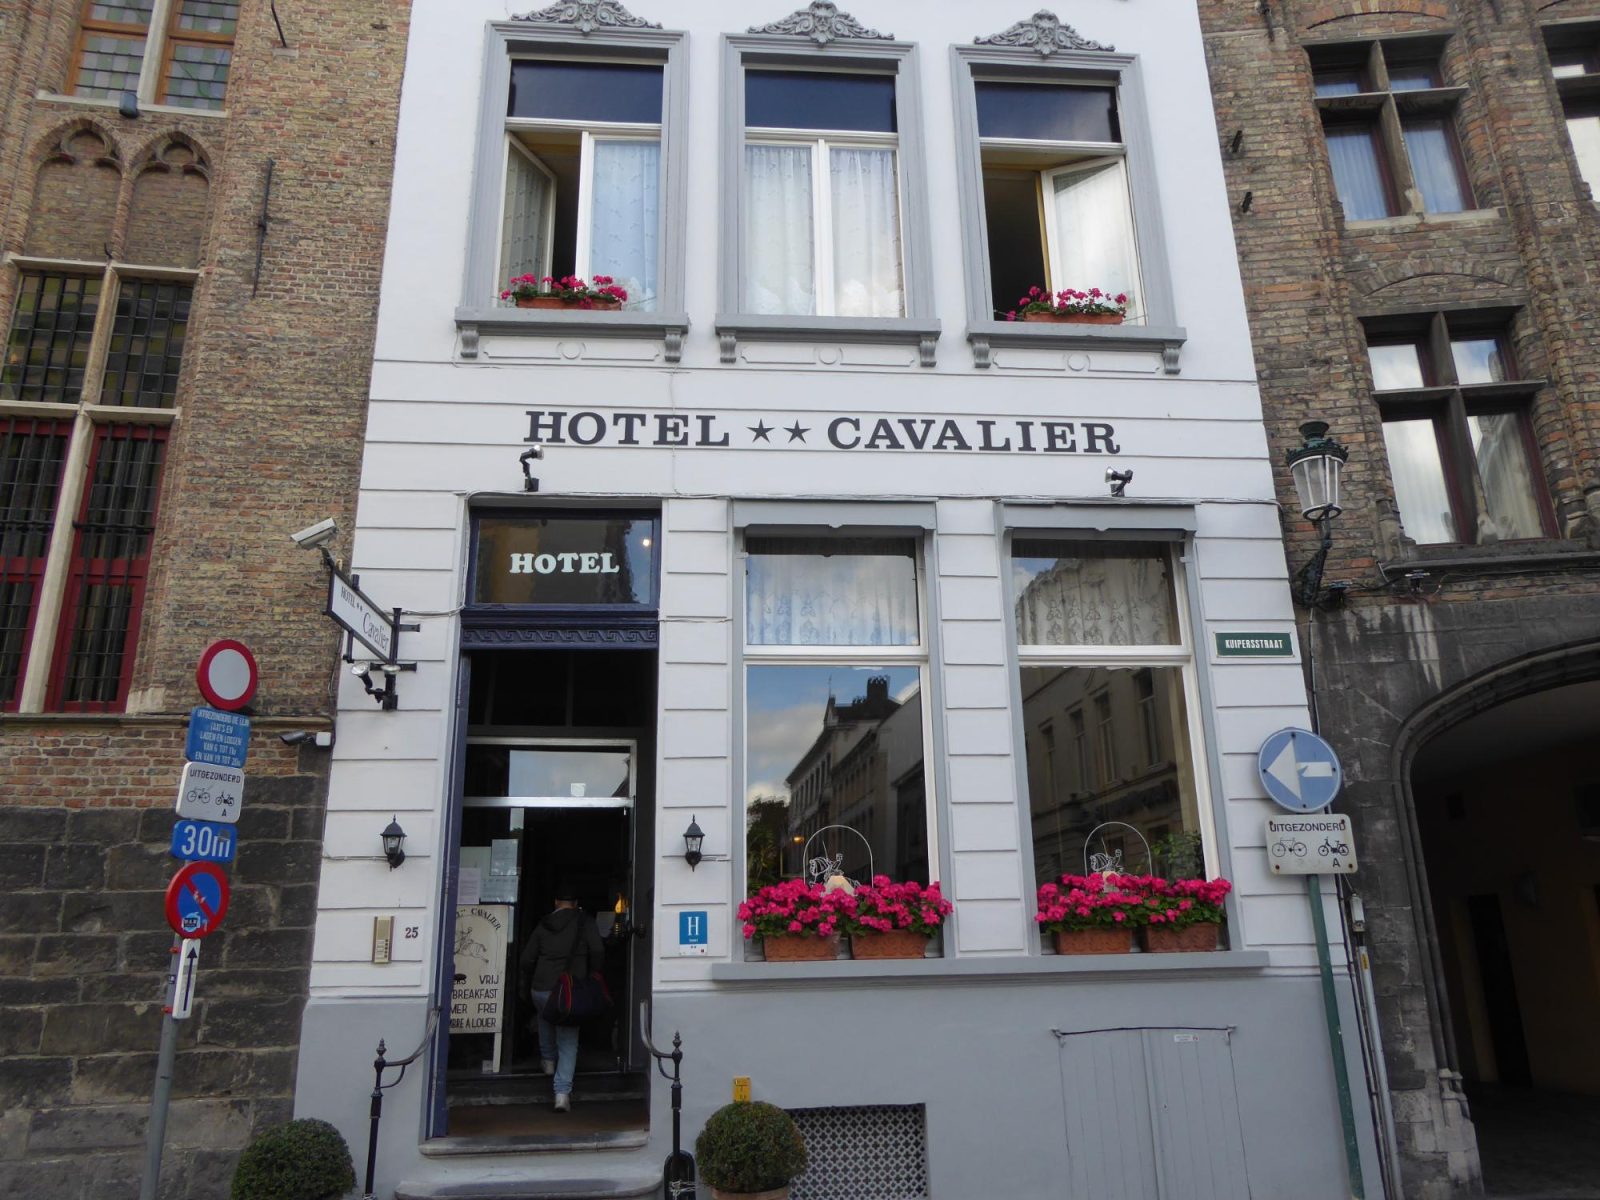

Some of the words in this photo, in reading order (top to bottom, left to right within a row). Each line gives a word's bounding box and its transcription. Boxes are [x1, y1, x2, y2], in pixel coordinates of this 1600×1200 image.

[524, 411, 730, 447] HOTEL
[827, 417, 1121, 454] CAVALIER
[509, 553, 620, 574] HOTEL
[341, 586, 356, 608] HOTEL
[363, 612, 389, 651] Cavalier
[1225, 639, 1283, 649] KUIPERSSTRAAT
[226, 725, 234, 734] EN
[203, 742, 214, 751] VAN
[219, 744, 228, 753] TOT
[195, 751, 203, 760] EN
[203, 753, 214, 762] VAN
[222, 755, 231, 764] TOT
[190, 769, 241, 784] UITGEZONDERD
[221, 808, 227, 817] A
[1269, 821, 1346, 833] UITGEZONDERD
[181, 824, 231, 858] 30m
[1332, 857, 1341, 868] A
[687, 916, 699, 936] H
[405, 926, 419, 939] 25
[479, 974, 500, 986] VRIJ
[452, 988, 498, 1000] BREAKFAST
[477, 1002, 497, 1014] FREI
[465, 1018, 471, 1029] A
[471, 1017, 496, 1029] LOUER
